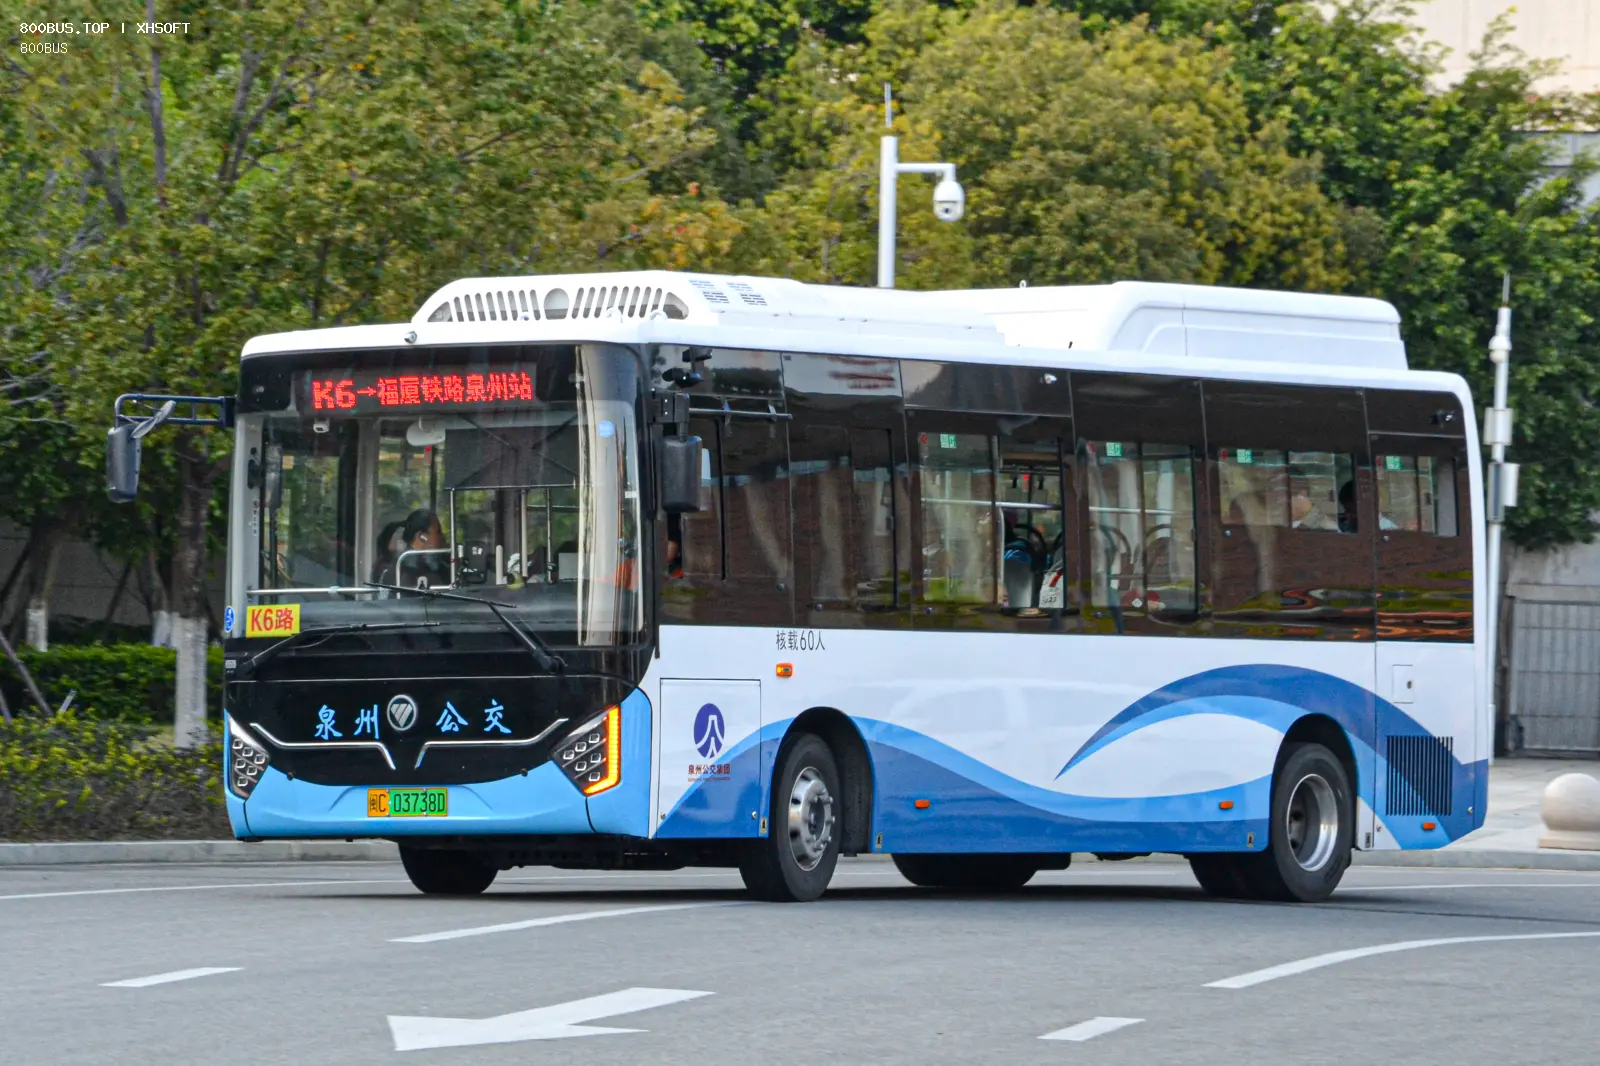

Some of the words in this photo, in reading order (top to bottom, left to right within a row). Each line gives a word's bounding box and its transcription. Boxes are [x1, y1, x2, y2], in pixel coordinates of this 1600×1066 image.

[312, 379, 357, 409] K6
[377, 372, 533, 405] 福厦铁路泉州站
[250, 608, 294, 632] K6路
[775, 630, 826, 651] 核载60人
[314, 704, 380, 741] 泉州
[436, 699, 512, 735] 公交
[688, 764, 731, 775] 泉州公交集团
[393, 792, 446, 813] 03738D
